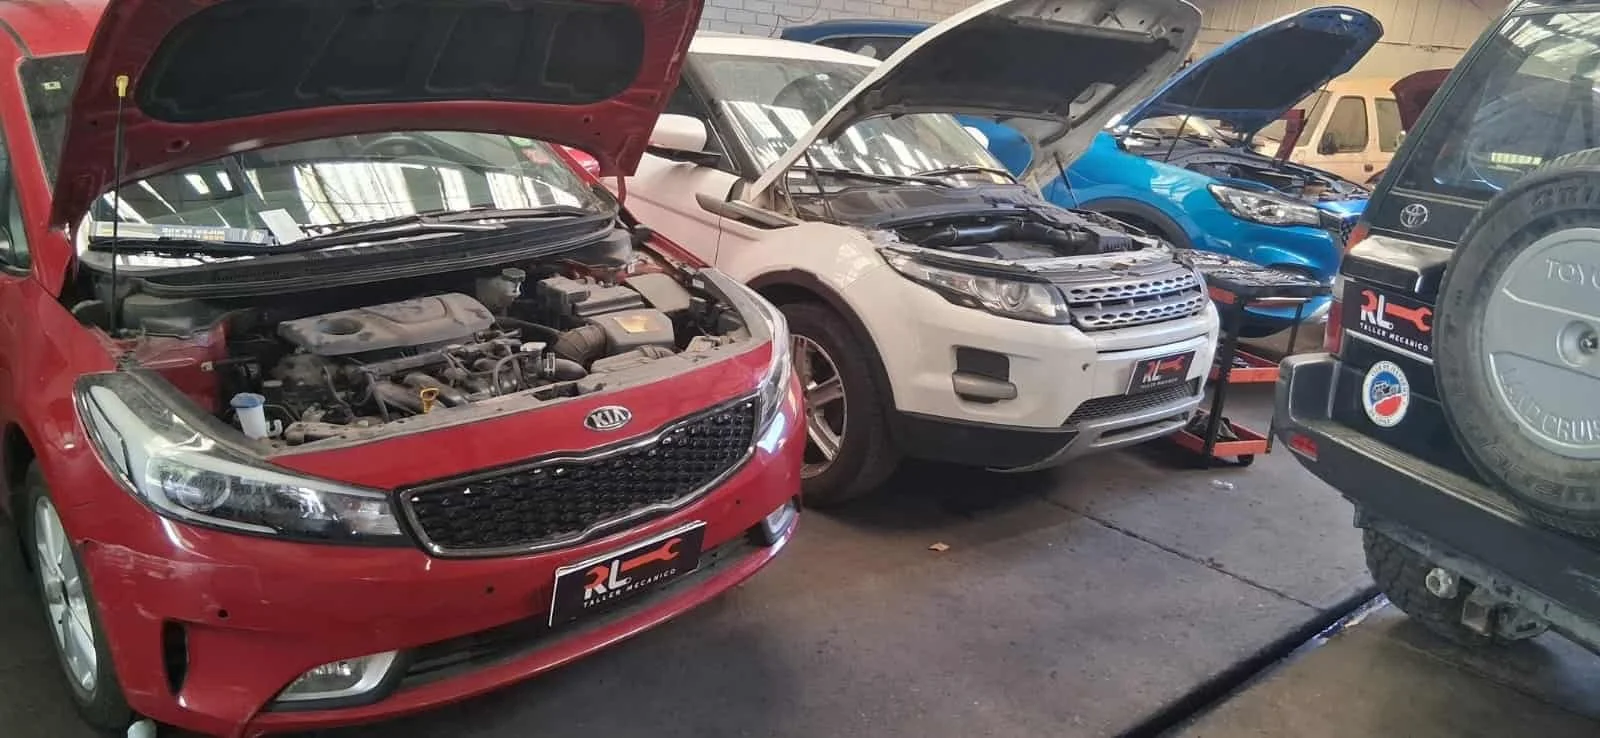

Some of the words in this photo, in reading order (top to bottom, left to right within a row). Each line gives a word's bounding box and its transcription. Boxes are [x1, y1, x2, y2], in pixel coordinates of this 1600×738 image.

[1360, 289, 1394, 330] RL
[1360, 322, 1386, 337] TALLER
[1389, 332, 1429, 352] MECANICO
[590, 409, 627, 427] KIA
[583, 559, 632, 601] RL
[583, 589, 622, 609] TALLER
[626, 568, 677, 592] MECANICO
